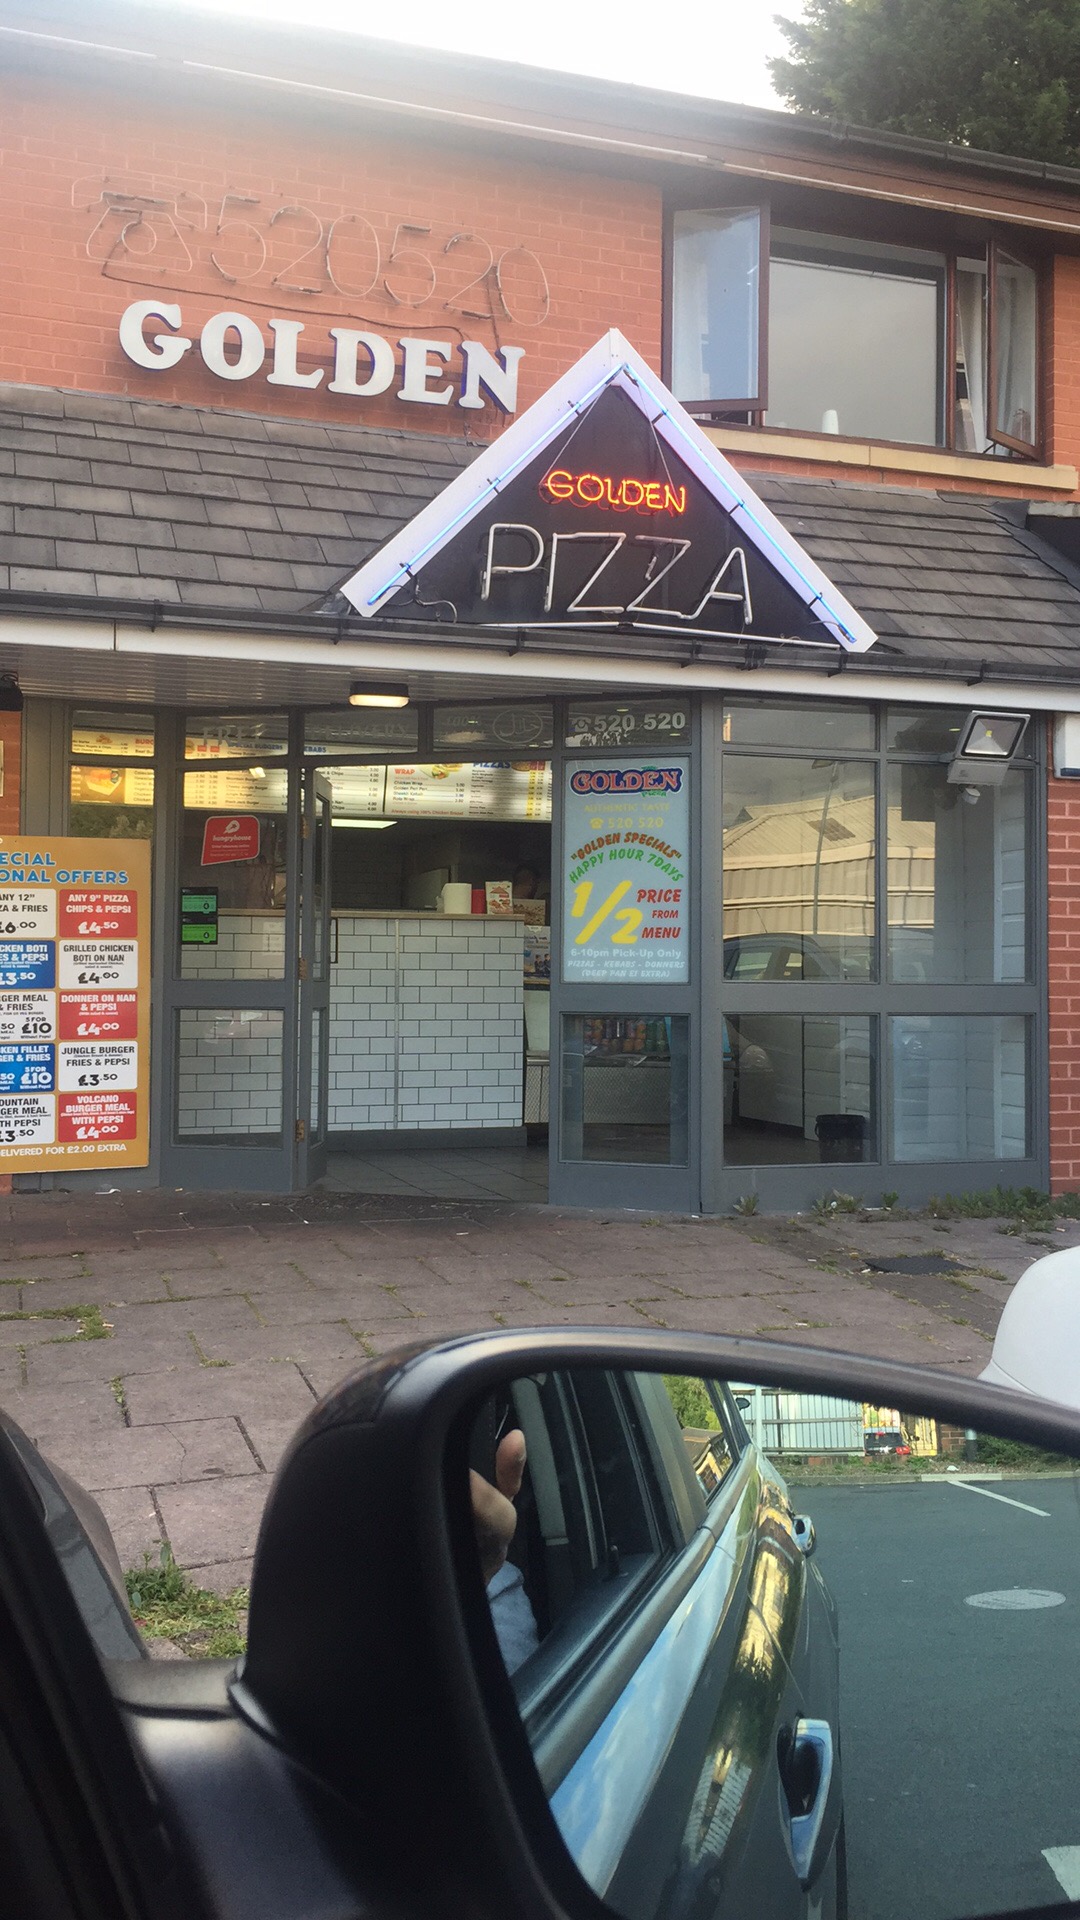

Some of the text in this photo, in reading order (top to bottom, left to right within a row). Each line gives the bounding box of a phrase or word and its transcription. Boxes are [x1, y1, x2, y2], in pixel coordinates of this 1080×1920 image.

[119, 300, 526, 414] GOLDEN
[545, 470, 687, 515] GOLDEN
[481, 522, 754, 625] PIZZA
[594, 712, 686, 733] 520 520
[572, 769, 681, 793] GOLDEN
[608, 817, 665, 829] 520 520
[212, 834, 252, 842] hungryhouse
[570, 832, 682, 860] "GOLDEN SPECIALS"
[0, 852, 56, 866] ECIAL
[569, 852, 605, 884] HAPPY
[609, 848, 645, 861] HOUR
[56, 869, 129, 884] OFFERS
[68, 894, 87, 902] ANY
[103, 894, 129, 902] PIZZA
[636, 889, 682, 903] PRICE
[12, 904, 19, 912] &
[22, 904, 48, 912] FRIES
[66, 904, 132, 913] CHIPS & PEPSI
[570, 880, 643, 945] 1/2
[652, 910, 679, 919] FROM
[78, 921, 119, 934] £4.50
[641, 927, 681, 939] MENU
[26, 944, 48, 953] BOTI
[63, 944, 134, 952] GRILLED CHICKEN
[11, 953, 19, 961] &
[21, 953, 49, 961] PEPSI
[73, 954, 91, 962] BOTI
[107, 954, 125, 962] NAN
[570, 948, 682, 960] 6-10pm Pick-Up Only
[603, 960, 636, 968] KEBABS
[645, 961, 685, 969] DONNERS
[78, 972, 119, 984] £4.00
[641, 969, 671, 978] EXTRA)
[61, 994, 136, 1003] DONNER ON NAN
[7, 1003, 33, 1011] FRIES
[80, 1003, 117, 1011] & PEPSI
[21, 1022, 52, 1034] £10
[77, 1022, 120, 1036] £4.00
[20, 1045, 49, 1053] FILLET
[61, 1045, 135, 1055] JUNGLE BURGER
[16, 1054, 24, 1062] &
[25, 1053, 51, 1061] FRIES
[66, 1058, 130, 1067] FRIES & PEPSI
[20, 1072, 52, 1085] £10
[78, 1073, 118, 1086] £3.50
[77, 1095, 119, 1103] VOLCANO
[22, 1106, 47, 1114] MEAL
[65, 1103, 130, 1113] BURGER MEAL
[14, 1119, 41, 1127] PEPSI
[72, 1115, 124, 1125] WITH PEPSI
[76, 1125, 119, 1139] £4.00
[45, 1146, 65, 1155] FOR
[67, 1145, 95, 1153] £2.00
[97, 1143, 127, 1152] EXTRA
